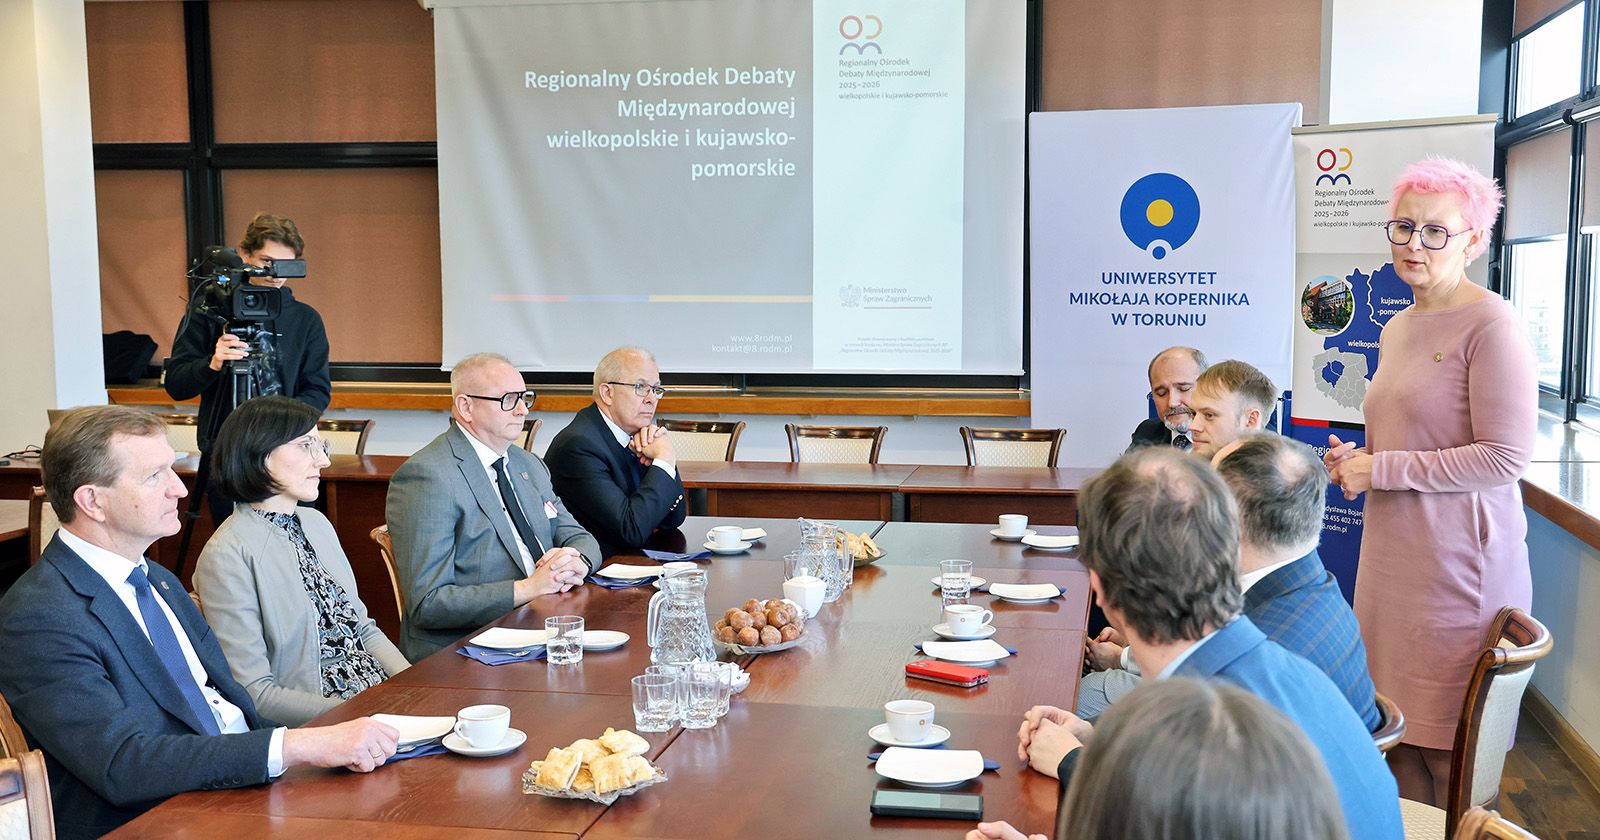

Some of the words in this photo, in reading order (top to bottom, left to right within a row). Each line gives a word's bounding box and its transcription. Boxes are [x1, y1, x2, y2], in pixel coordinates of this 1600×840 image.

[839, 59, 879, 68] Regionalny
[880, 58, 911, 66] Ośrodek
[839, 70, 865, 78] Debaty
[866, 68, 931, 78] Międzynarodowej
[524, 70, 631, 92] Regionalny
[636, 67, 719, 87] Ośrodek
[725, 66, 796, 89] Debaty
[838, 92, 880, 100] wielkopolskie
[885, 91, 949, 100] kujawsko-pomorskie
[617, 97, 796, 120] Międzynarodowej
[546, 129, 679, 151] wielkopolskie
[685, 128, 690, 146] i
[696, 128, 796, 150] kujawsko-
[691, 158, 796, 180] pomorskie
[1315, 189, 1347, 197] Regionalny
[1349, 188, 1375, 196] Ośrodek
[1314, 199, 1336, 207] Debaty
[1101, 272, 1217, 285] UNIWERSYTET
[863, 295, 884, 303] Spraw
[885, 295, 933, 303] Zagranicznych
[1069, 292, 1150, 306] MIKOŁAJA
[1155, 292, 1250, 306] KOPERNIKA
[1380, 297, 1411, 306] kujawsko
[1111, 313, 1128, 325] W
[1132, 313, 1206, 326] TORUNIU
[711, 344, 793, 354] kontakt@8.rodm.pl
[1330, 515, 1340, 523] 455
[1341, 516, 1351, 524] 402
[1351, 518, 1362, 526] 747
